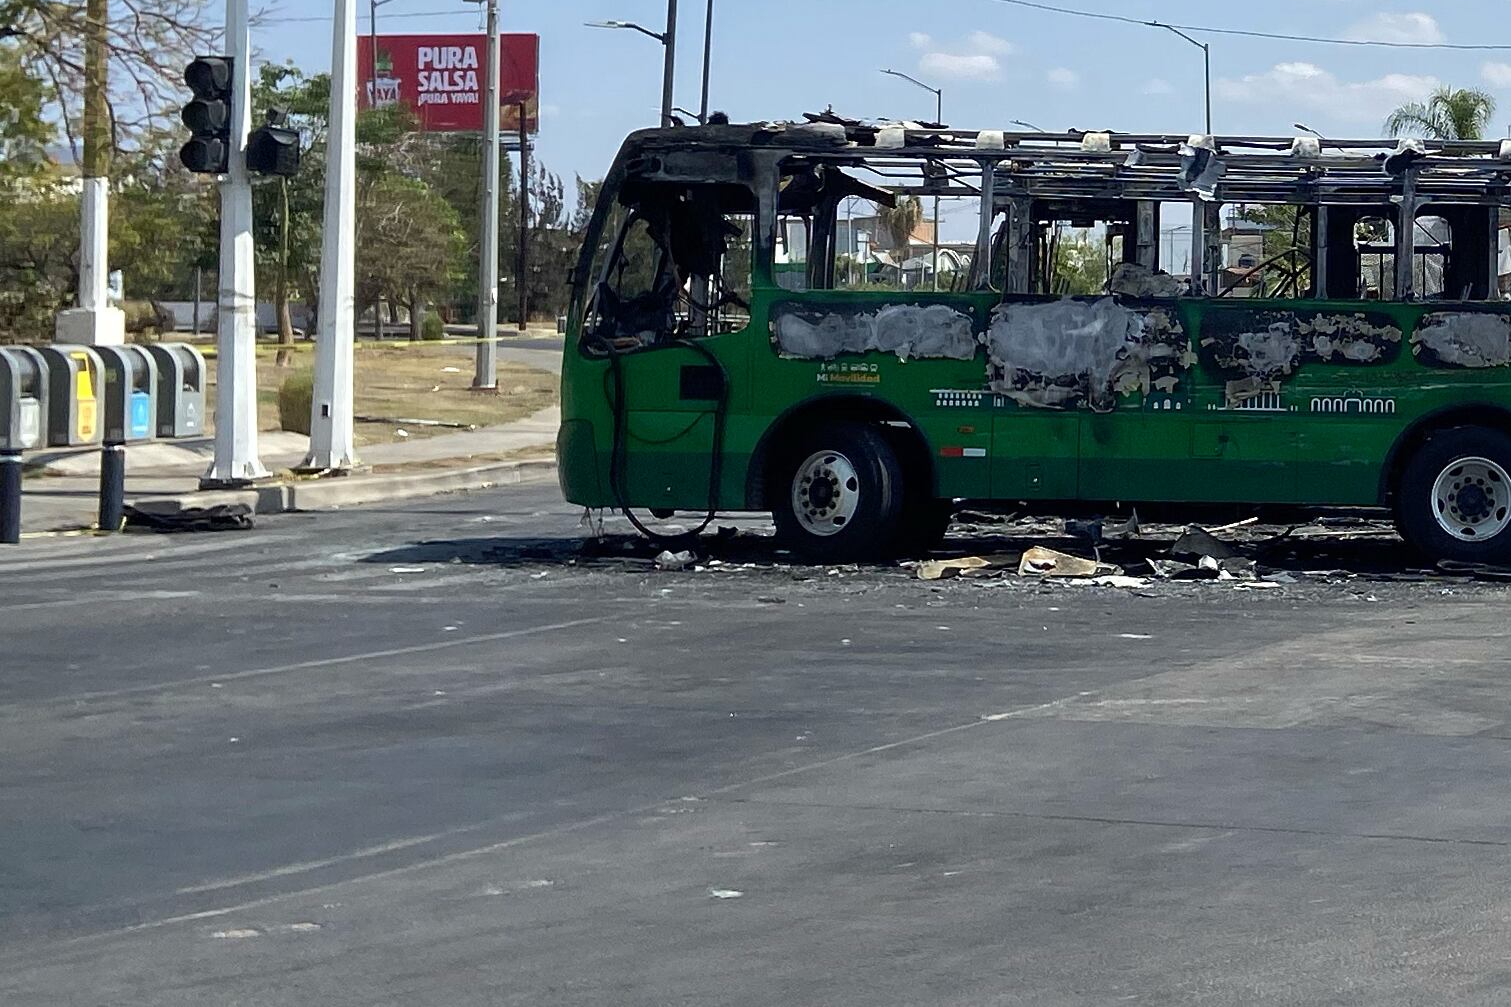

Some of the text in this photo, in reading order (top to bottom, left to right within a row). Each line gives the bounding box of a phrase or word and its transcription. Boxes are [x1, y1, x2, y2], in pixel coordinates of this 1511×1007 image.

[418, 46, 478, 69] PURA
[417, 71, 478, 91] SALSA
[418, 93, 479, 106] ¡PURA YAYA!
[816, 373, 880, 382] Mi Movilidad
